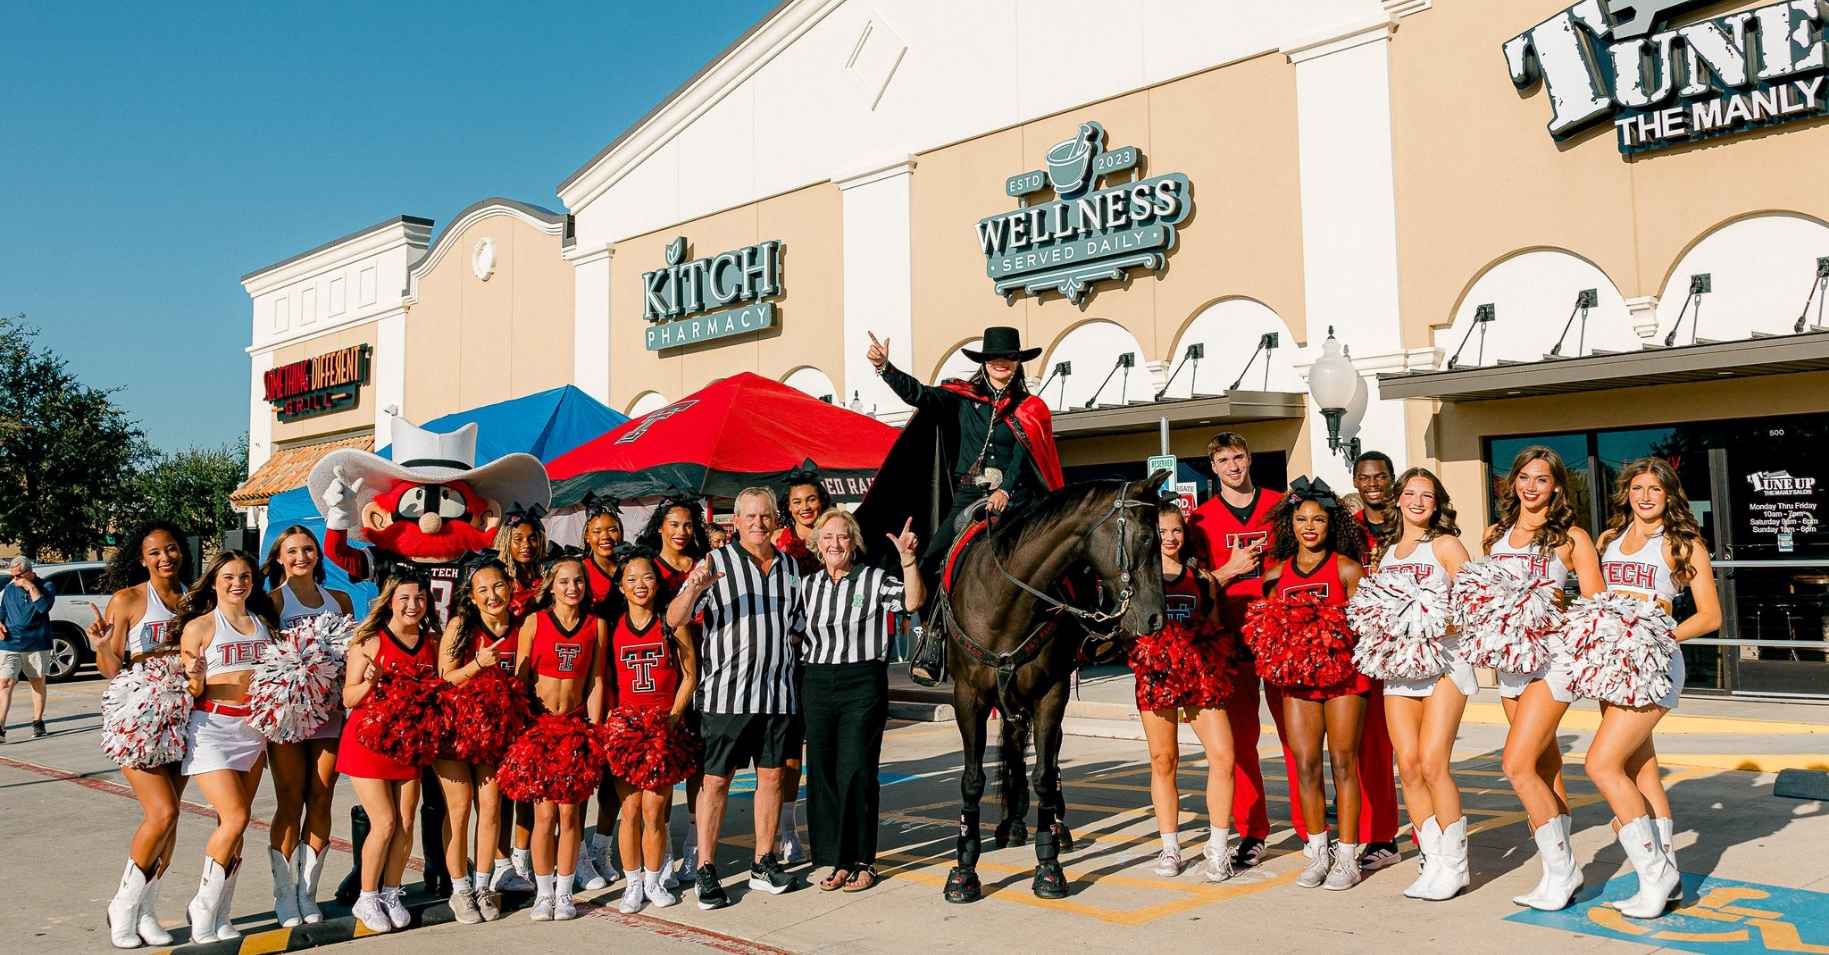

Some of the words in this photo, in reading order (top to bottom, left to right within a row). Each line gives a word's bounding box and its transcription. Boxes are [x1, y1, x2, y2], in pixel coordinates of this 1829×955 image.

[1503, 0, 1829, 132] TUNE
[1615, 107, 1685, 147] THE
[1691, 76, 1825, 132] MANLY
[1009, 174, 1040, 193] ESTD
[1098, 151, 1131, 169] 2023
[975, 179, 1177, 255] WELLNESS
[1001, 246, 1075, 272] SERVED
[1087, 231, 1144, 255] DAILY
[642, 240, 778, 321] KITCH
[648, 307, 767, 347] PHARMACY
[311, 345, 361, 391] DIFFERENT
[1746, 470, 1793, 492] TUNE
[1794, 478, 1816, 490] UP
[1749, 503, 1776, 511] Monday
[1777, 502, 1794, 510] Thru
[1794, 502, 1817, 510] Friday
[1750, 518, 1781, 527] Saturday
[1752, 526, 1778, 534] Sunday
[430, 567, 459, 579] TECH
[216, 639, 272, 667] TEC
